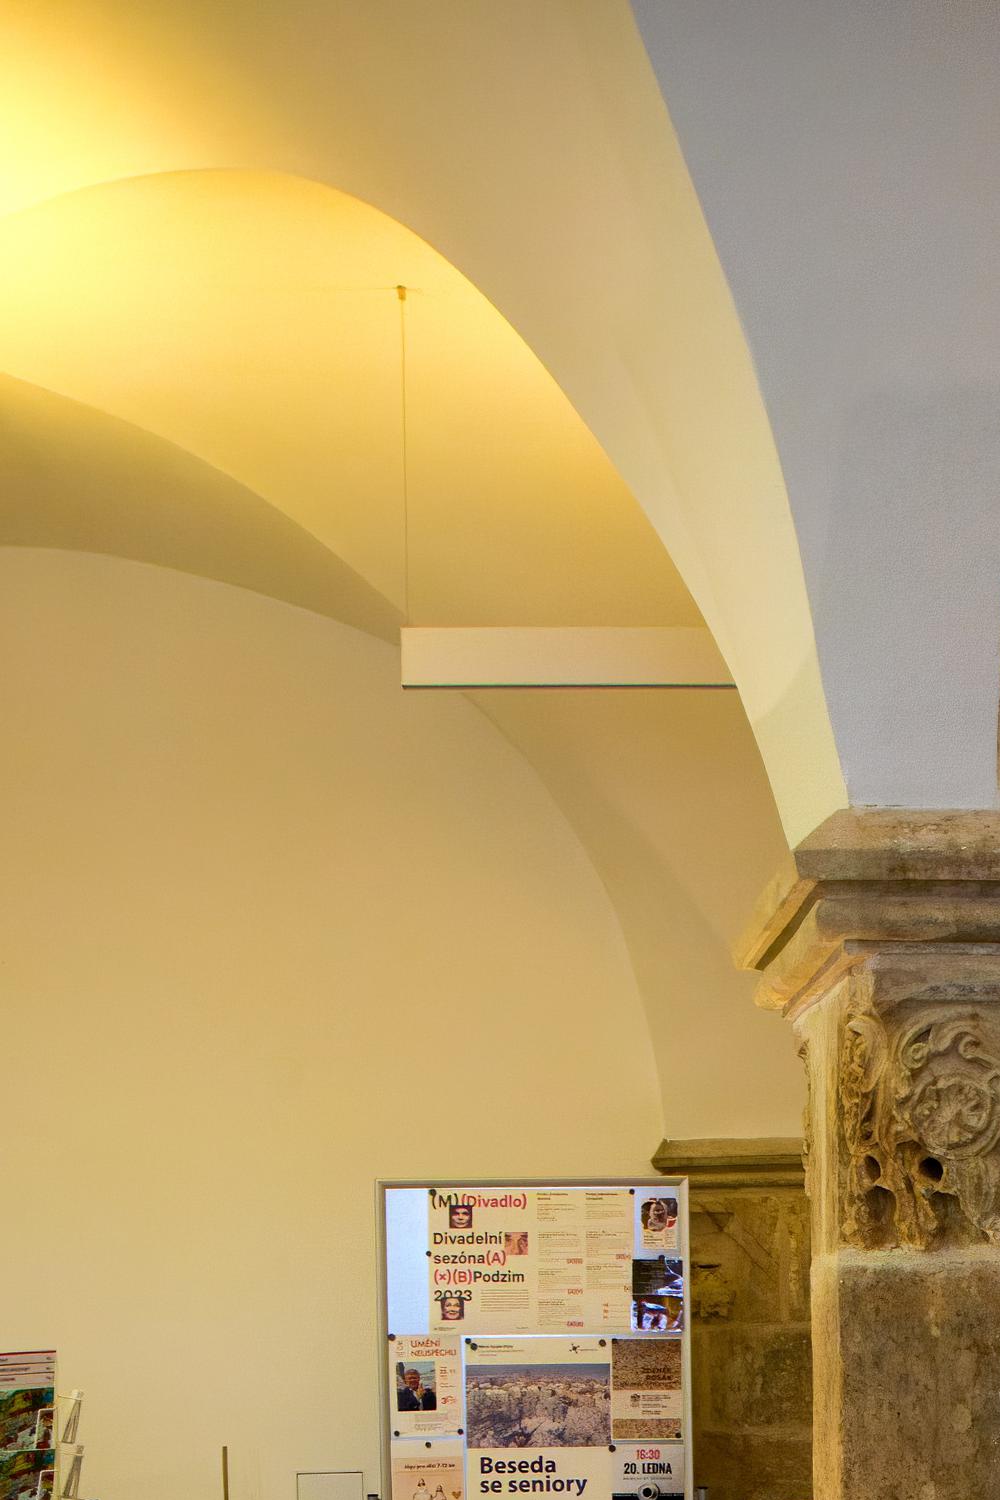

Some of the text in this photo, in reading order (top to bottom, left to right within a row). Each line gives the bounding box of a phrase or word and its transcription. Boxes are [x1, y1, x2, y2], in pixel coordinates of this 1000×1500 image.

[433, 1231, 502, 1245] Divadelní
[636, 1449, 661, 1460] 16:30
[480, 1456, 556, 1474] Beseda
[624, 1463, 672, 1474] 20. LEDNA
[480, 1475, 588, 1496] se seniory
